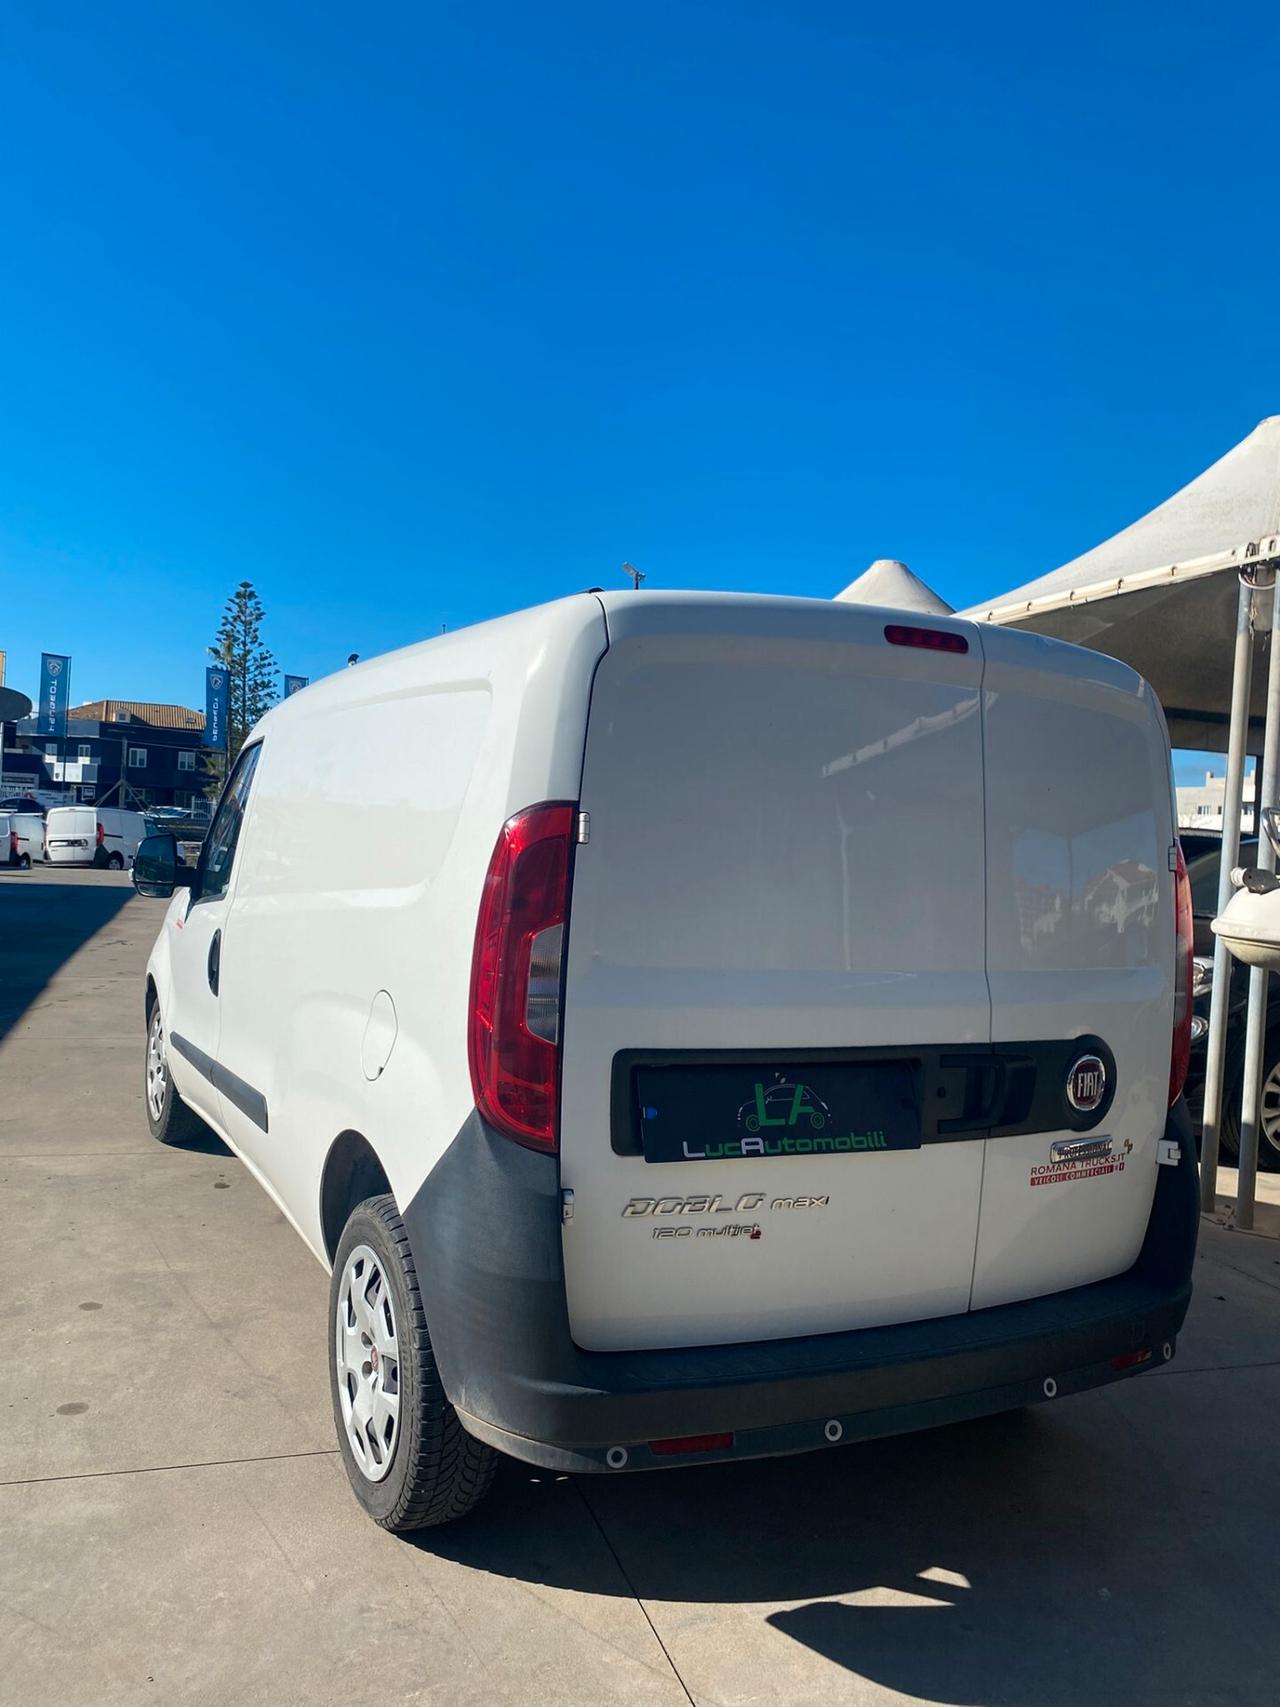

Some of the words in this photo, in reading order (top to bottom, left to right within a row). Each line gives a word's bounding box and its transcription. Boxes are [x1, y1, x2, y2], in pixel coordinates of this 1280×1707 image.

[1077, 1071, 1099, 1098] FIAT
[1030, 1161, 1077, 1176] ROMANA
[1079, 1153, 1125, 1168] TRUCKS.IT
[770, 1195, 830, 1211] maxi
[652, 1226, 693, 1239] 120
